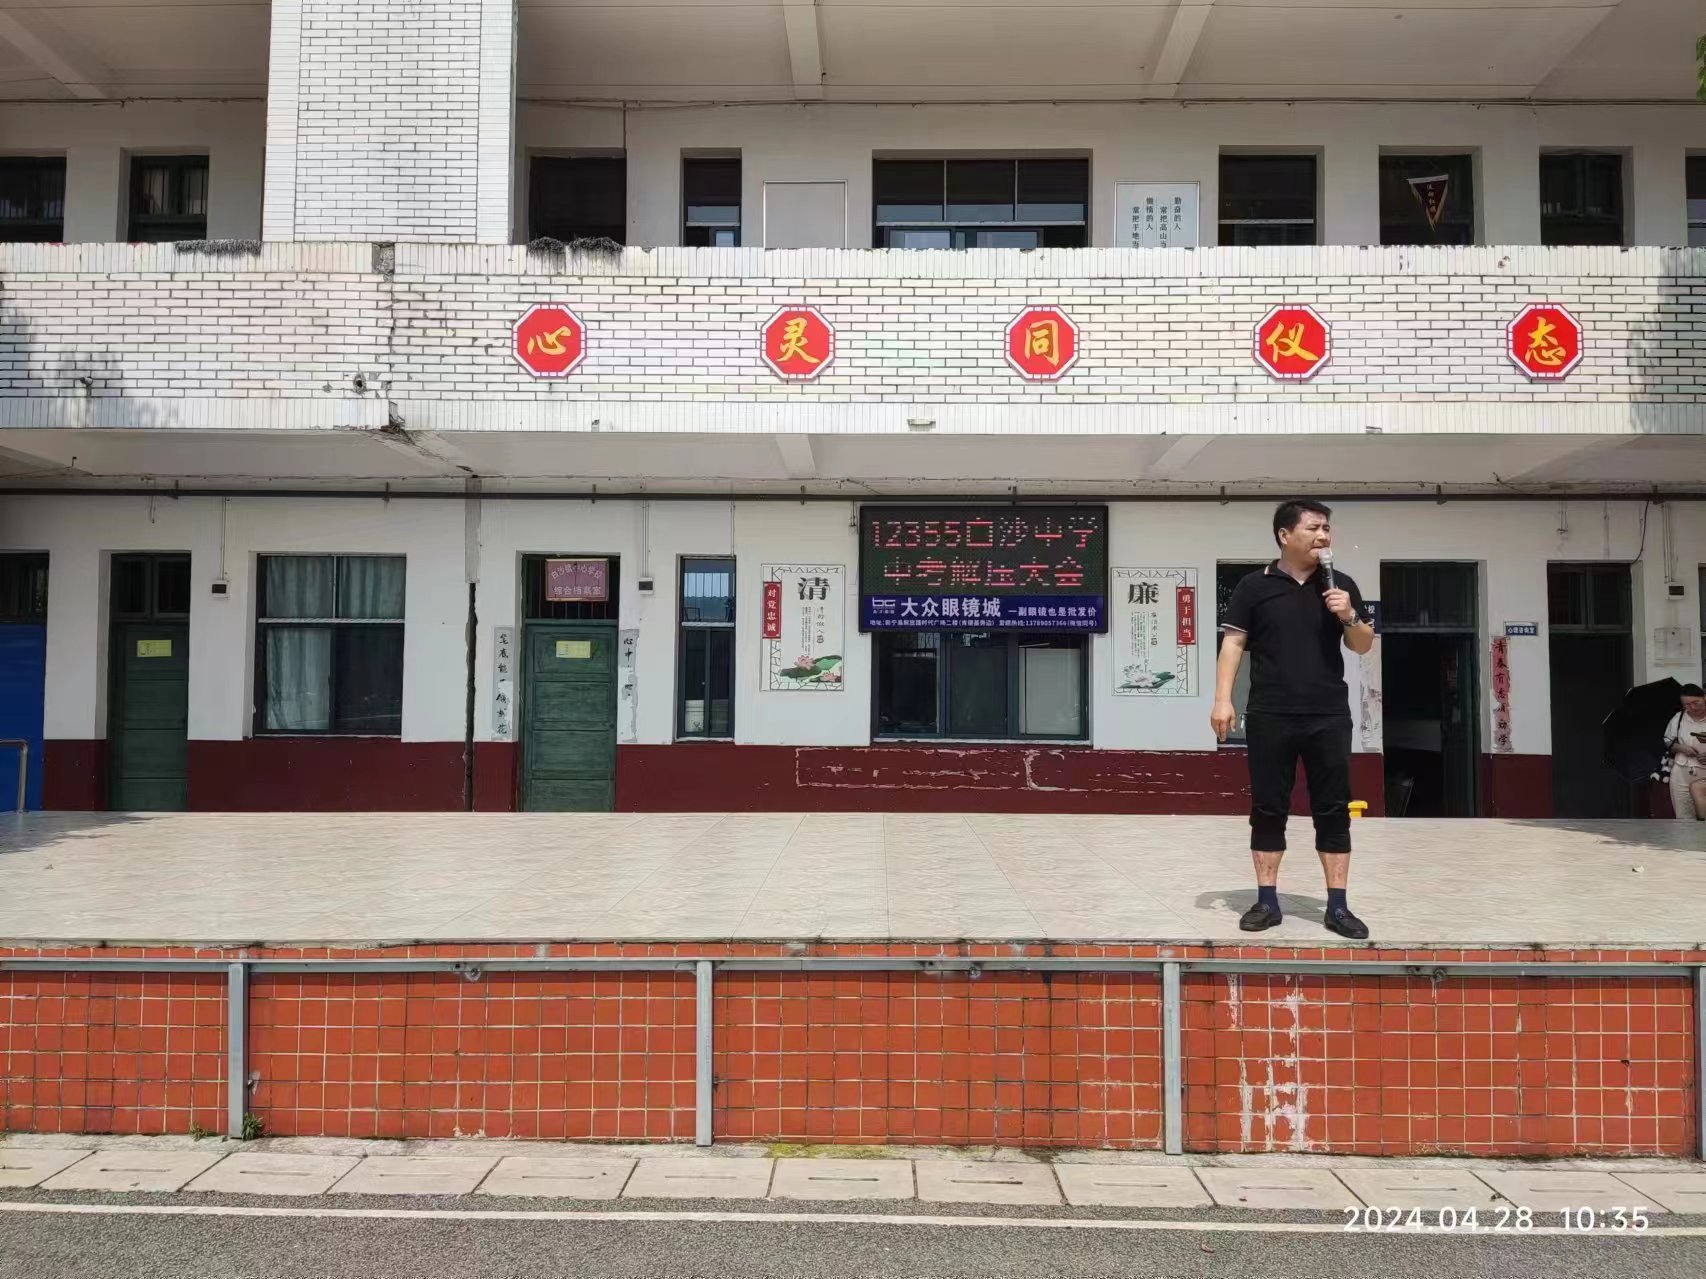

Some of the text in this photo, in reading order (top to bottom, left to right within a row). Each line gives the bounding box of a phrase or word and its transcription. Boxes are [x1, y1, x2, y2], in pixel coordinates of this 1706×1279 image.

[1173, 196, 1182, 231] 勤奋的人
[527, 316, 1567, 366] 心 灵 同 仪 态
[798, 577, 830, 600] 清
[1128, 582, 1159, 604] 廉
[766, 588, 777, 632] 对党忠诚
[900, 597, 1001, 617] 大众眼镜城
[1008, 606, 1097, 617] 一副眼镜也是批发价
[1181, 594, 1192, 638] 勇于担当
